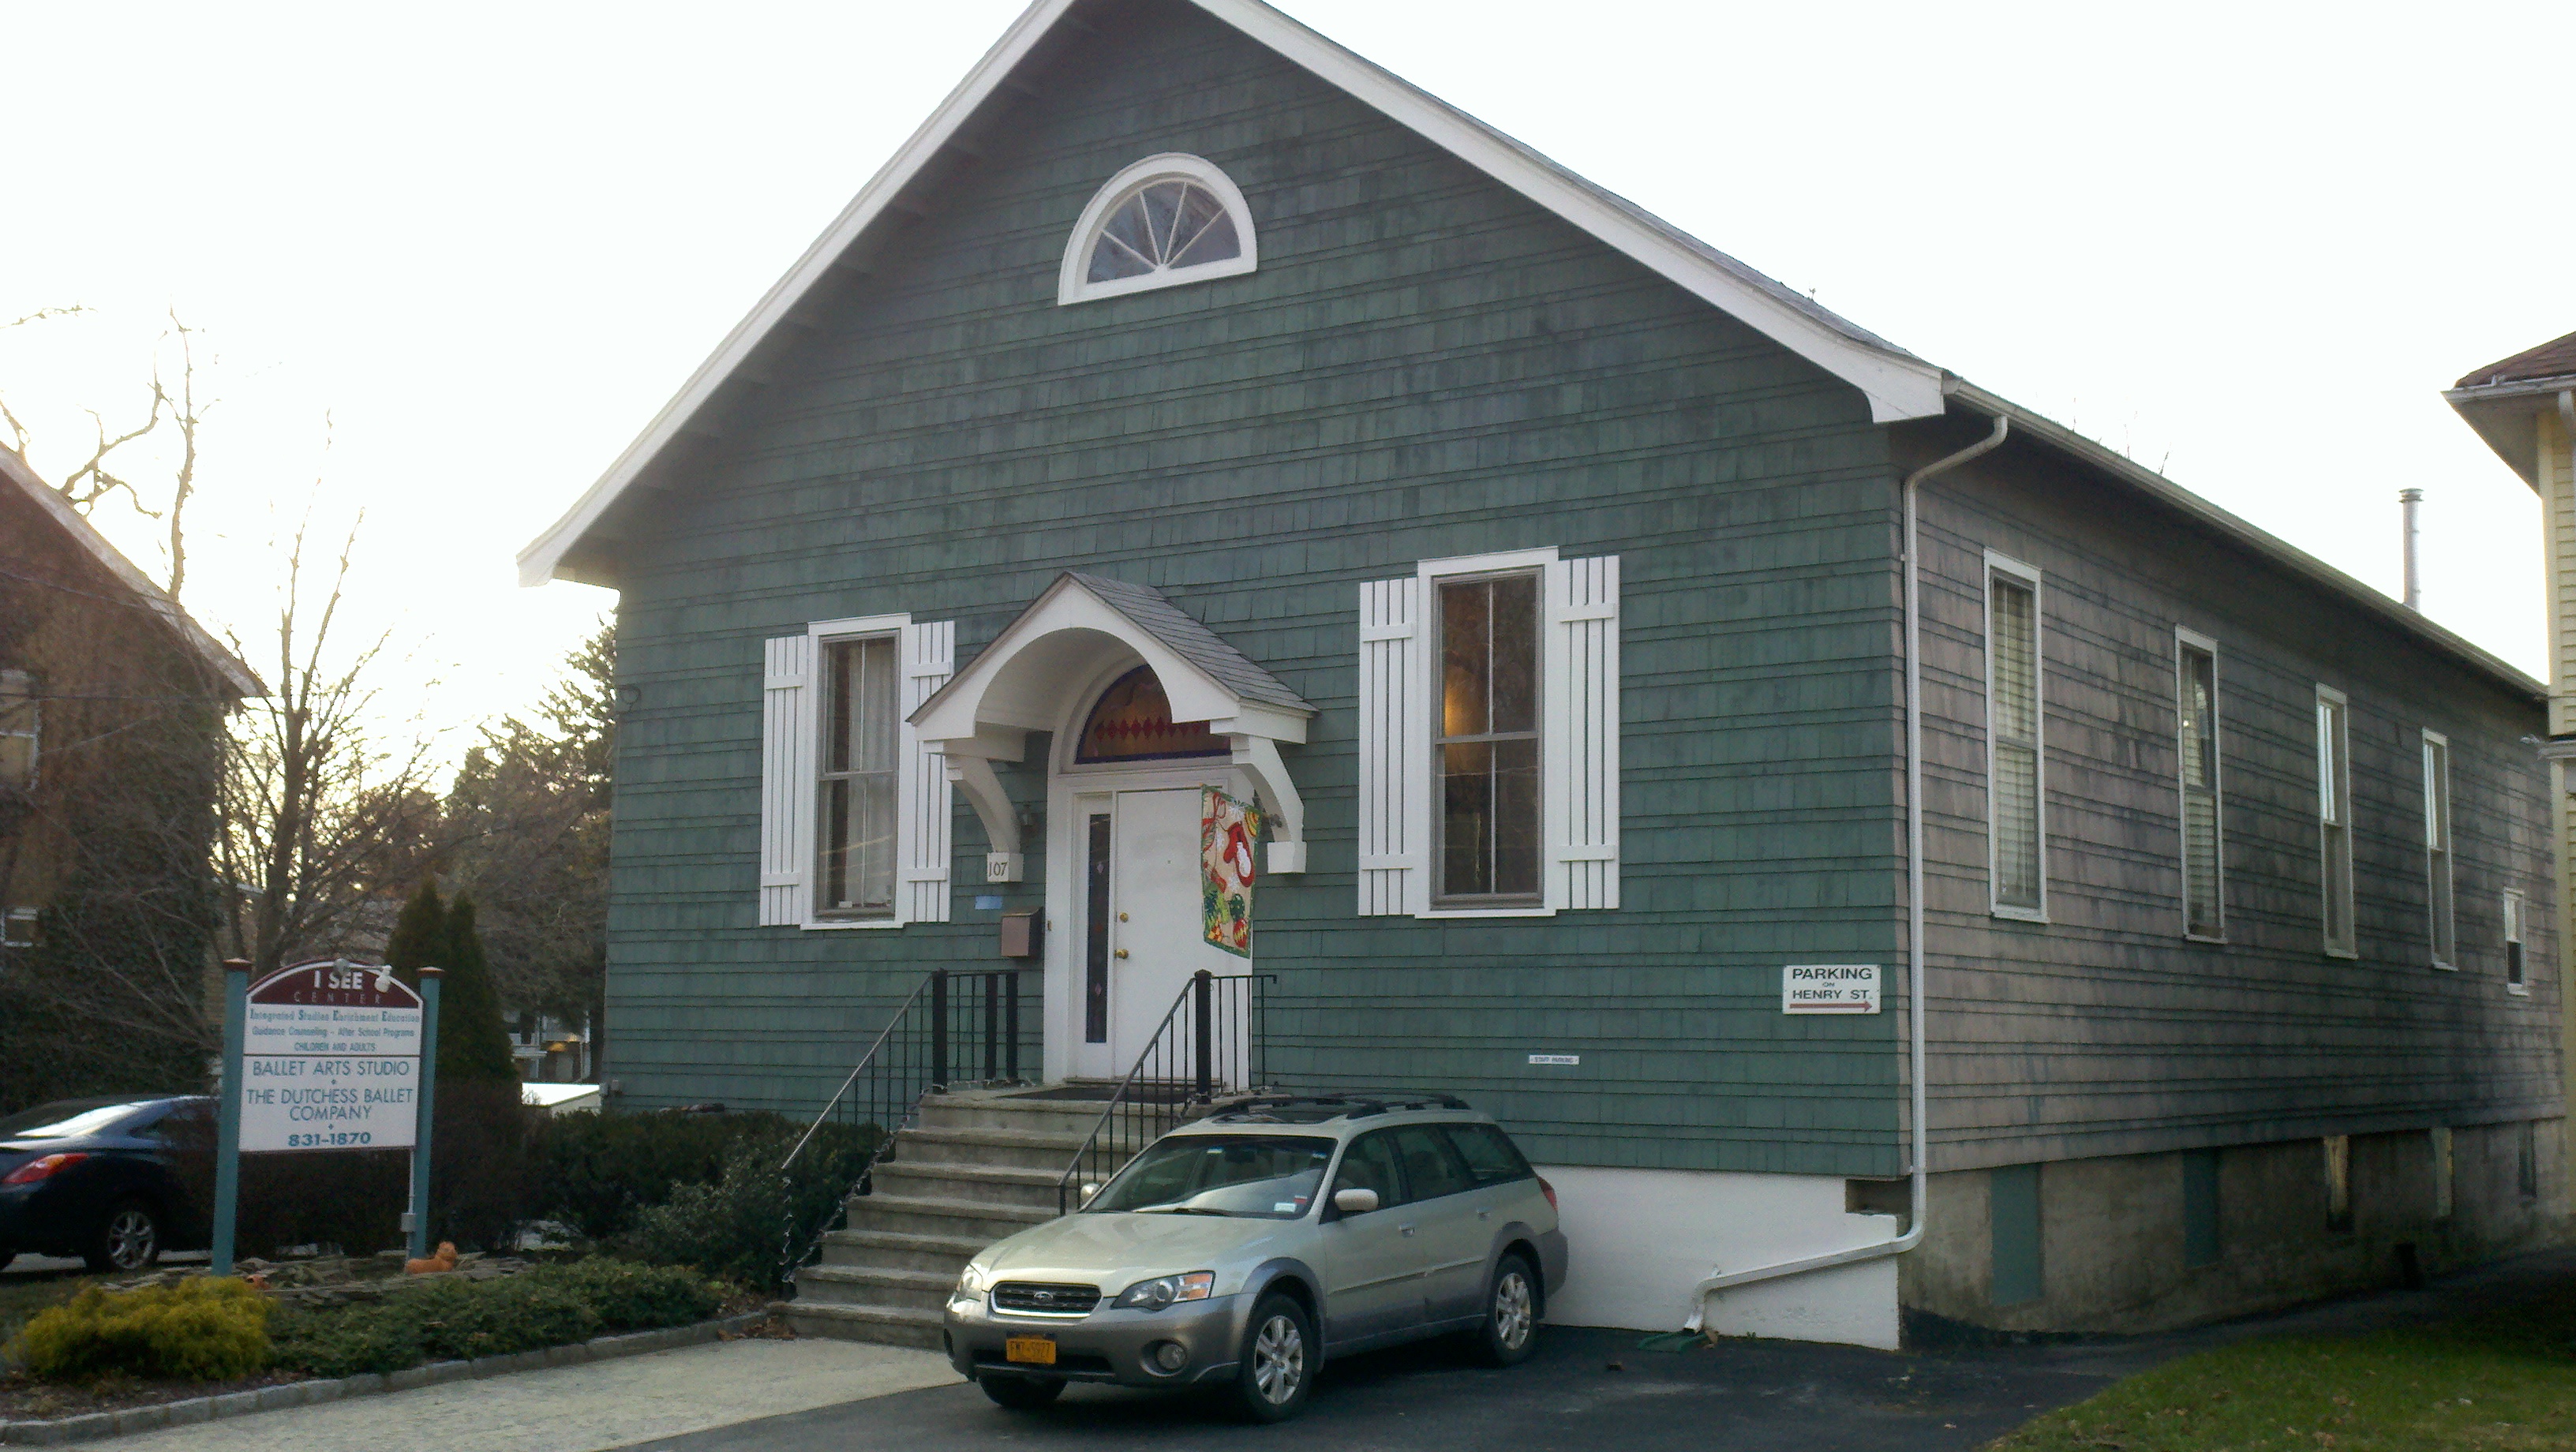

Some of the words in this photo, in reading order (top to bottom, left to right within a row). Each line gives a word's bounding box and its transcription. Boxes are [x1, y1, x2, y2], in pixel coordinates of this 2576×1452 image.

[989, 862, 1008, 877] 107
[313, 970, 322, 989] I
[328, 971, 364, 990] SEE
[1792, 967, 1873, 980] PARKING
[294, 991, 381, 1005] CENTER
[1792, 990, 1843, 1000] HENRY
[250, 1009, 294, 1023] Integrated
[382, 1011, 421, 1023] Education
[253, 1061, 306, 1076] BALLET
[313, 1061, 351, 1076] ARTS
[357, 1061, 410, 1076] STUDIO
[246, 1089, 275, 1105] THE
[281, 1088, 358, 1104] DUTCHESS
[364, 1088, 414, 1103] BALLET
[289, 1106, 372, 1121] COMPANY
[288, 1132, 372, 1147] 831-1870
